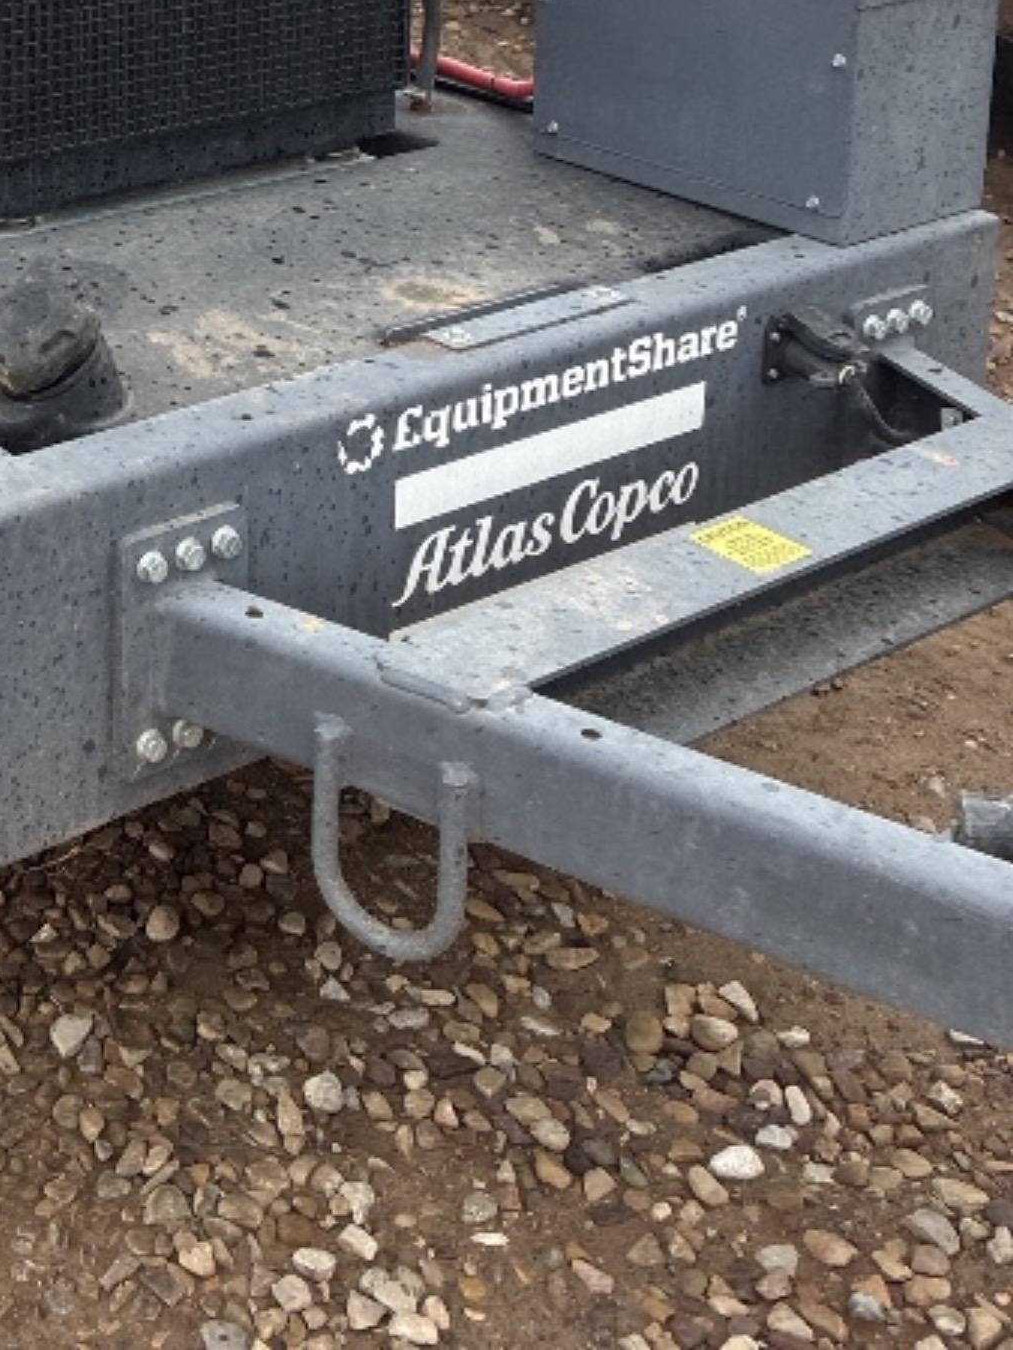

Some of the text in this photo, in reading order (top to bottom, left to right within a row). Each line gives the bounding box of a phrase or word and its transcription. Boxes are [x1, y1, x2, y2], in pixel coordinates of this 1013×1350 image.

[391, 316, 740, 452] EquipmentShare
[391, 508, 555, 609] Atlas
[559, 460, 701, 543] Copco
